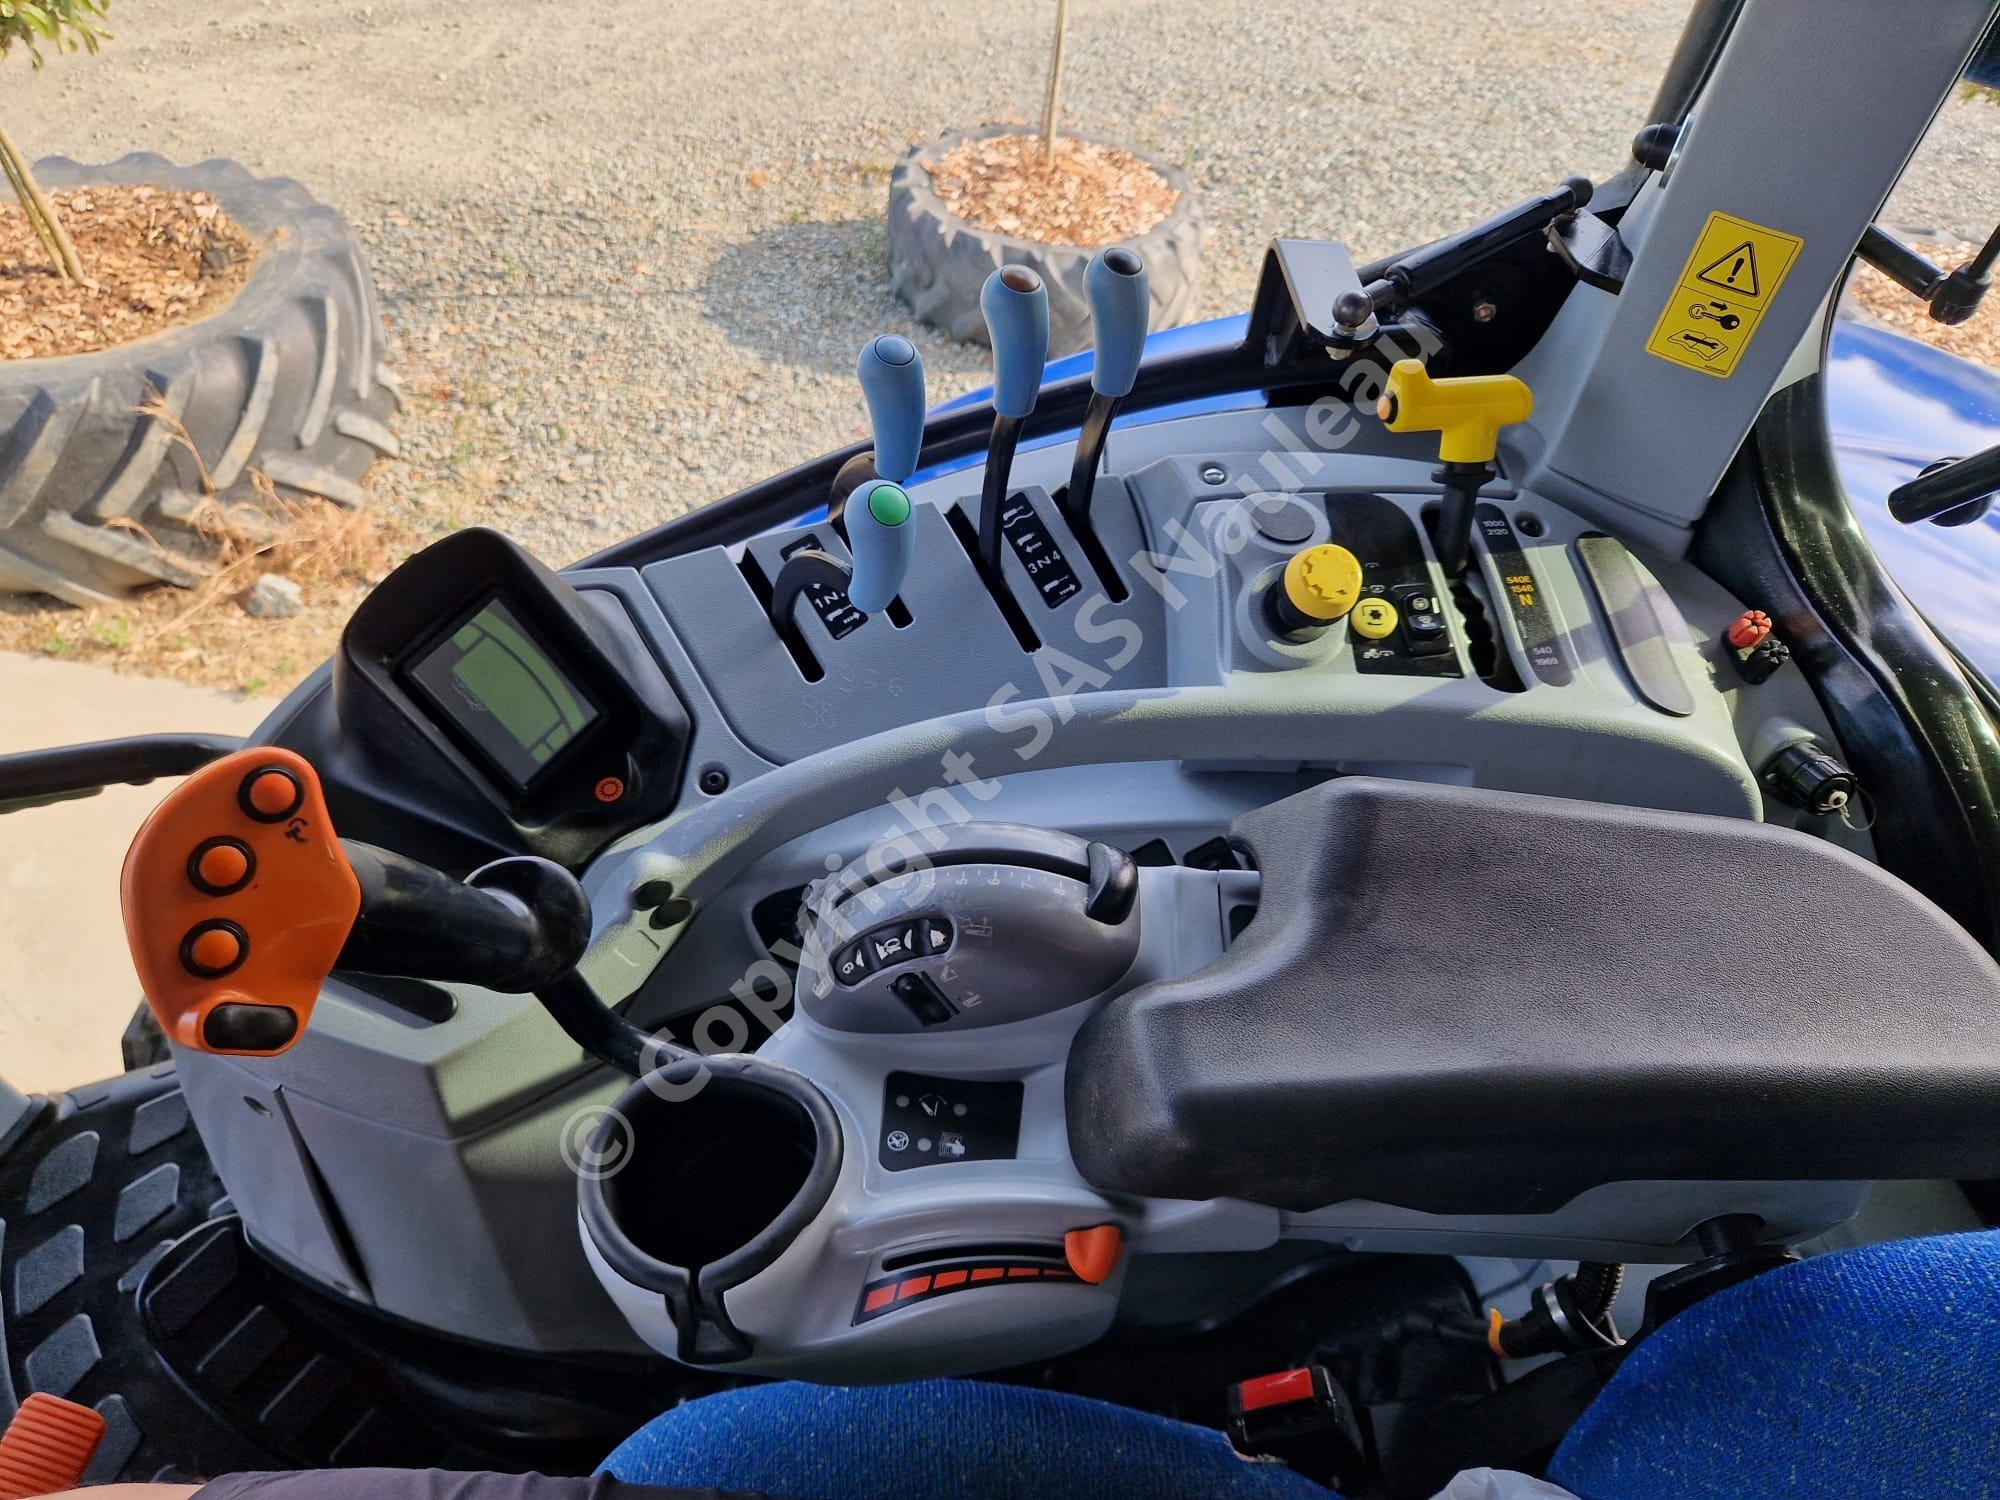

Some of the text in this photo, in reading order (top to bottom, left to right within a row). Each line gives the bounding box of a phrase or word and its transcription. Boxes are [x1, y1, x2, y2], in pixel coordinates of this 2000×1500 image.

[1028, 550, 1061, 574] 3 N 4
[1506, 576, 1532, 584] 540E
[815, 599, 823, 609] 1
[824, 592, 839, 605] N
[1519, 594, 1534, 606] N
[1532, 646, 1553, 655] 540
[956, 878, 968, 886] 5
[988, 878, 1001, 886] 6
